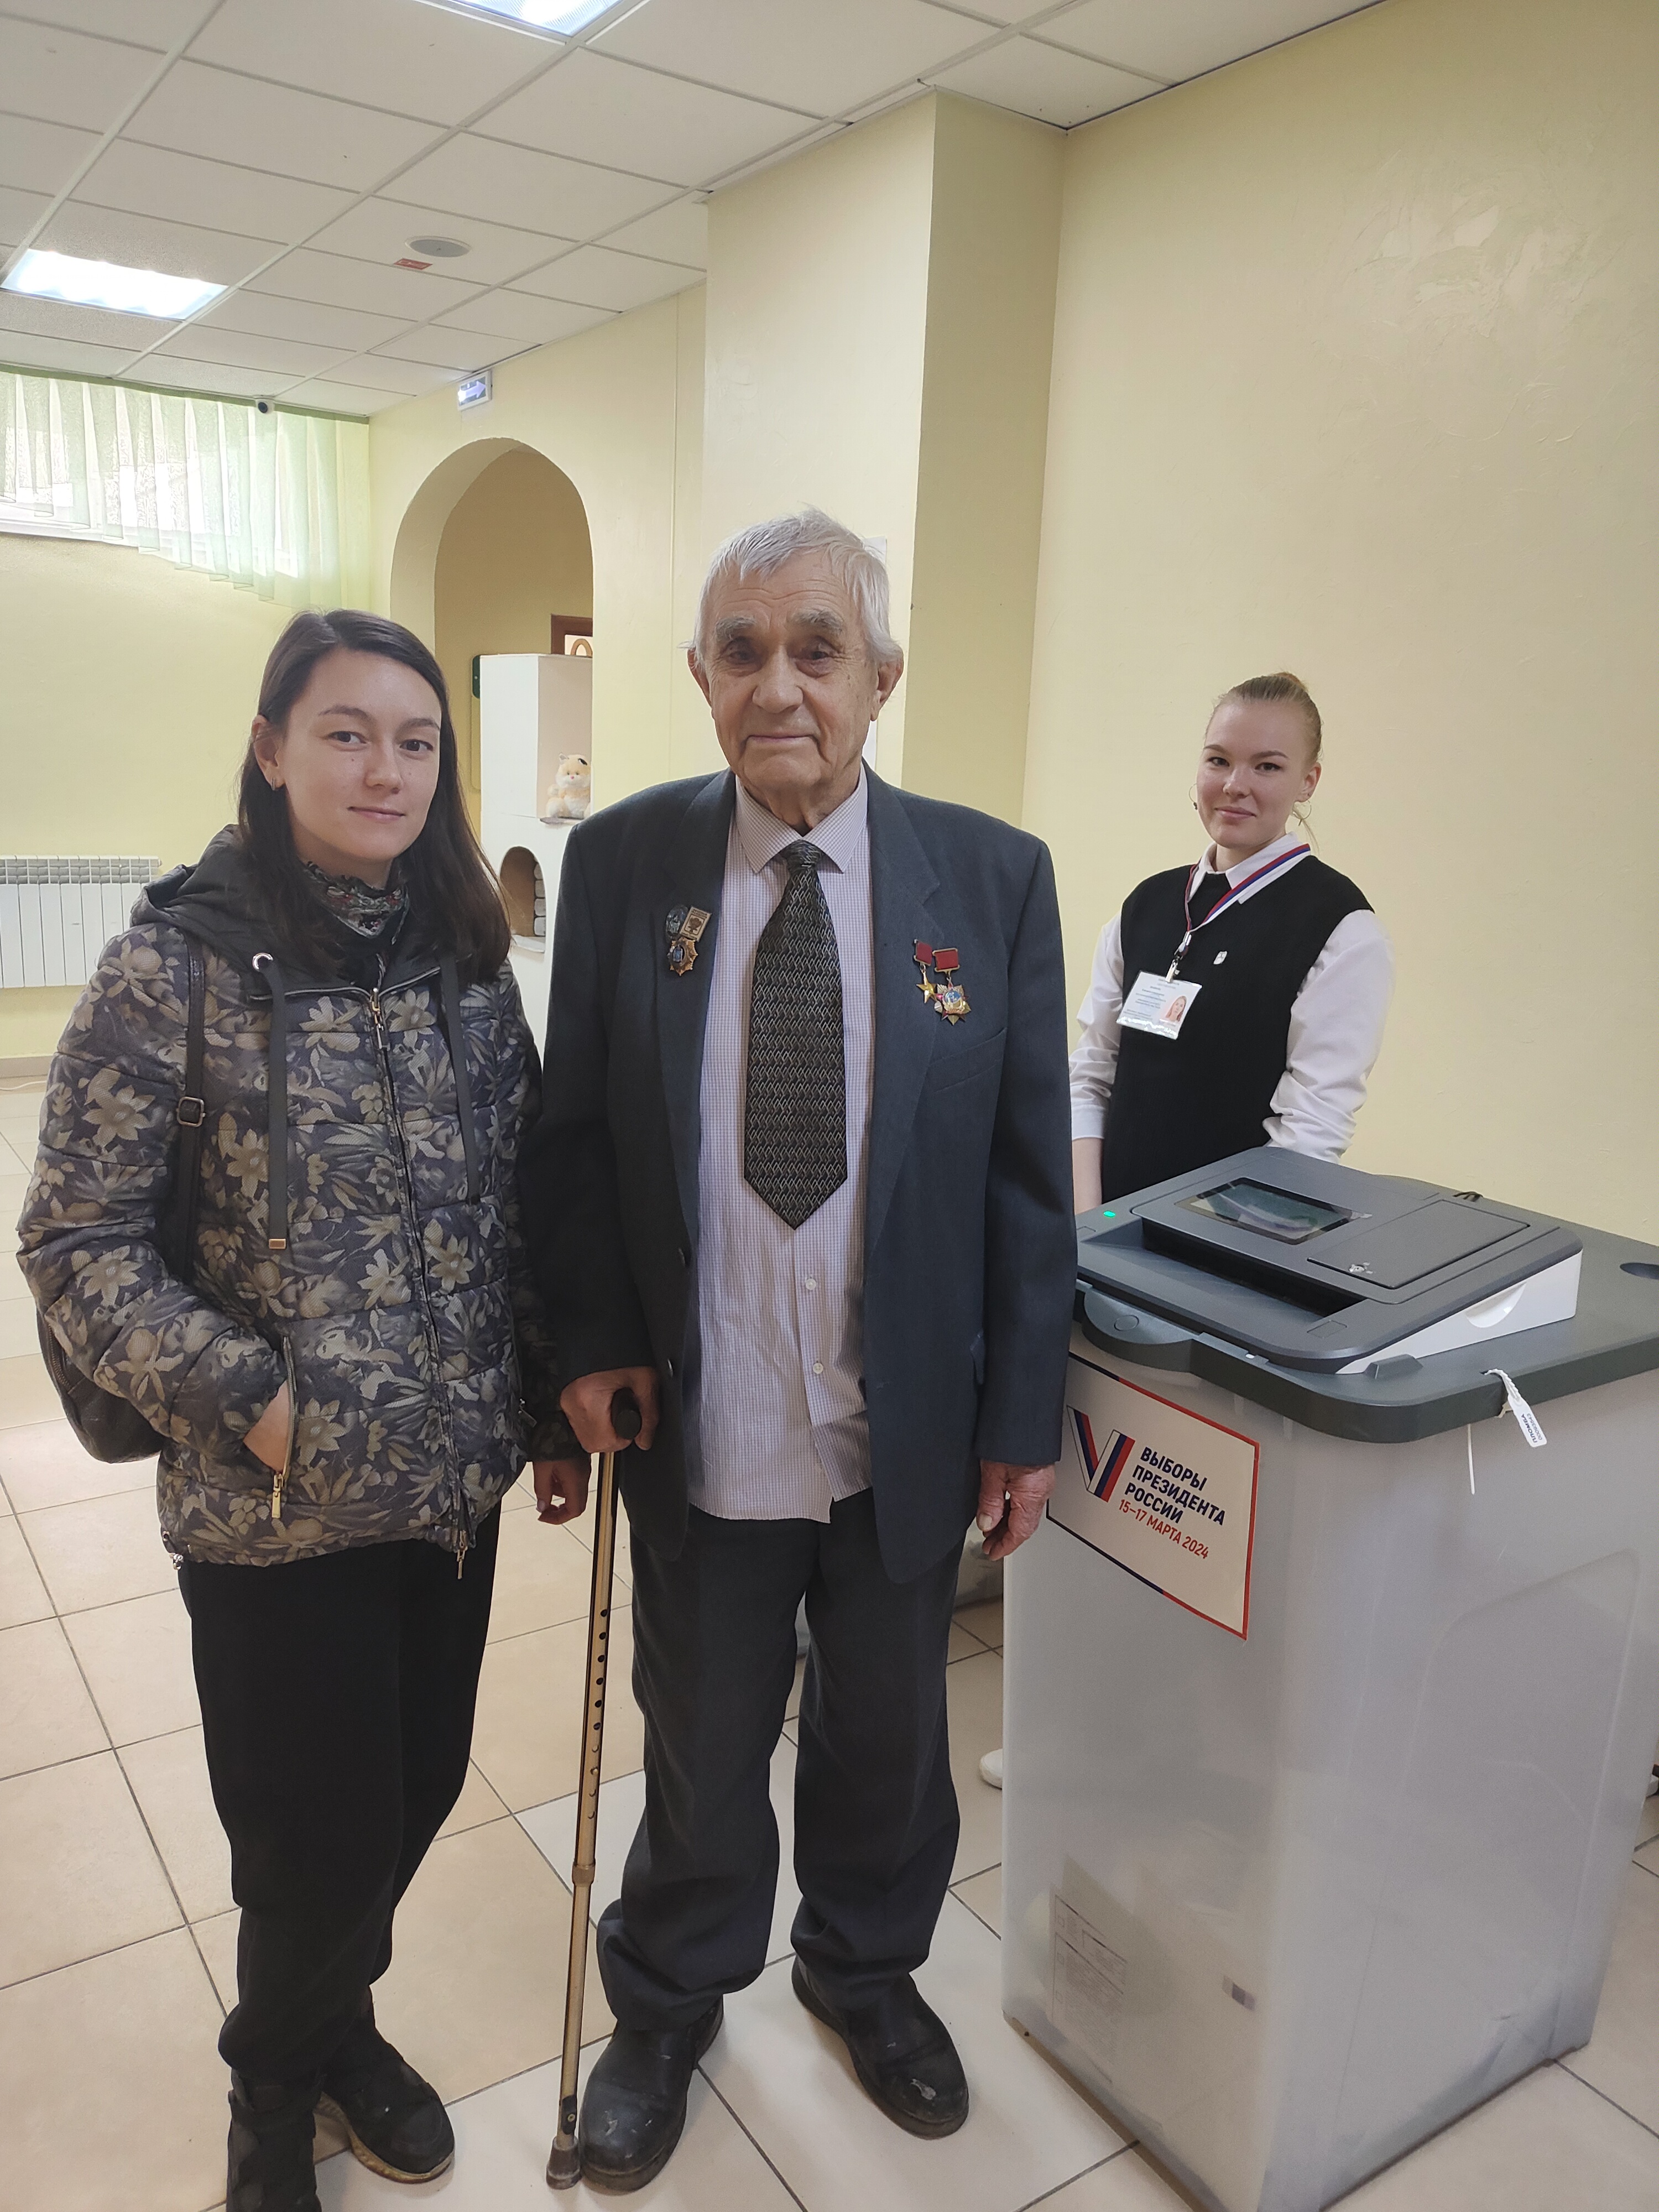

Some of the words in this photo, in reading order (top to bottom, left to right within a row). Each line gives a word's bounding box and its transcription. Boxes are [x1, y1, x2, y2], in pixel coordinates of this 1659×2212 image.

[1521, 1413, 1538, 1443] ПЛОМБА
[1140, 1447, 1208, 1491] ВЫБОРЫ
[1124, 1482, 1183, 1524] РОССИИ
[1132, 1464, 1225, 1526] ПРЕЗИДЕНТА
[1146, 1514, 1182, 1544] МАРТА
[1181, 1536, 1209, 1559] 2024
